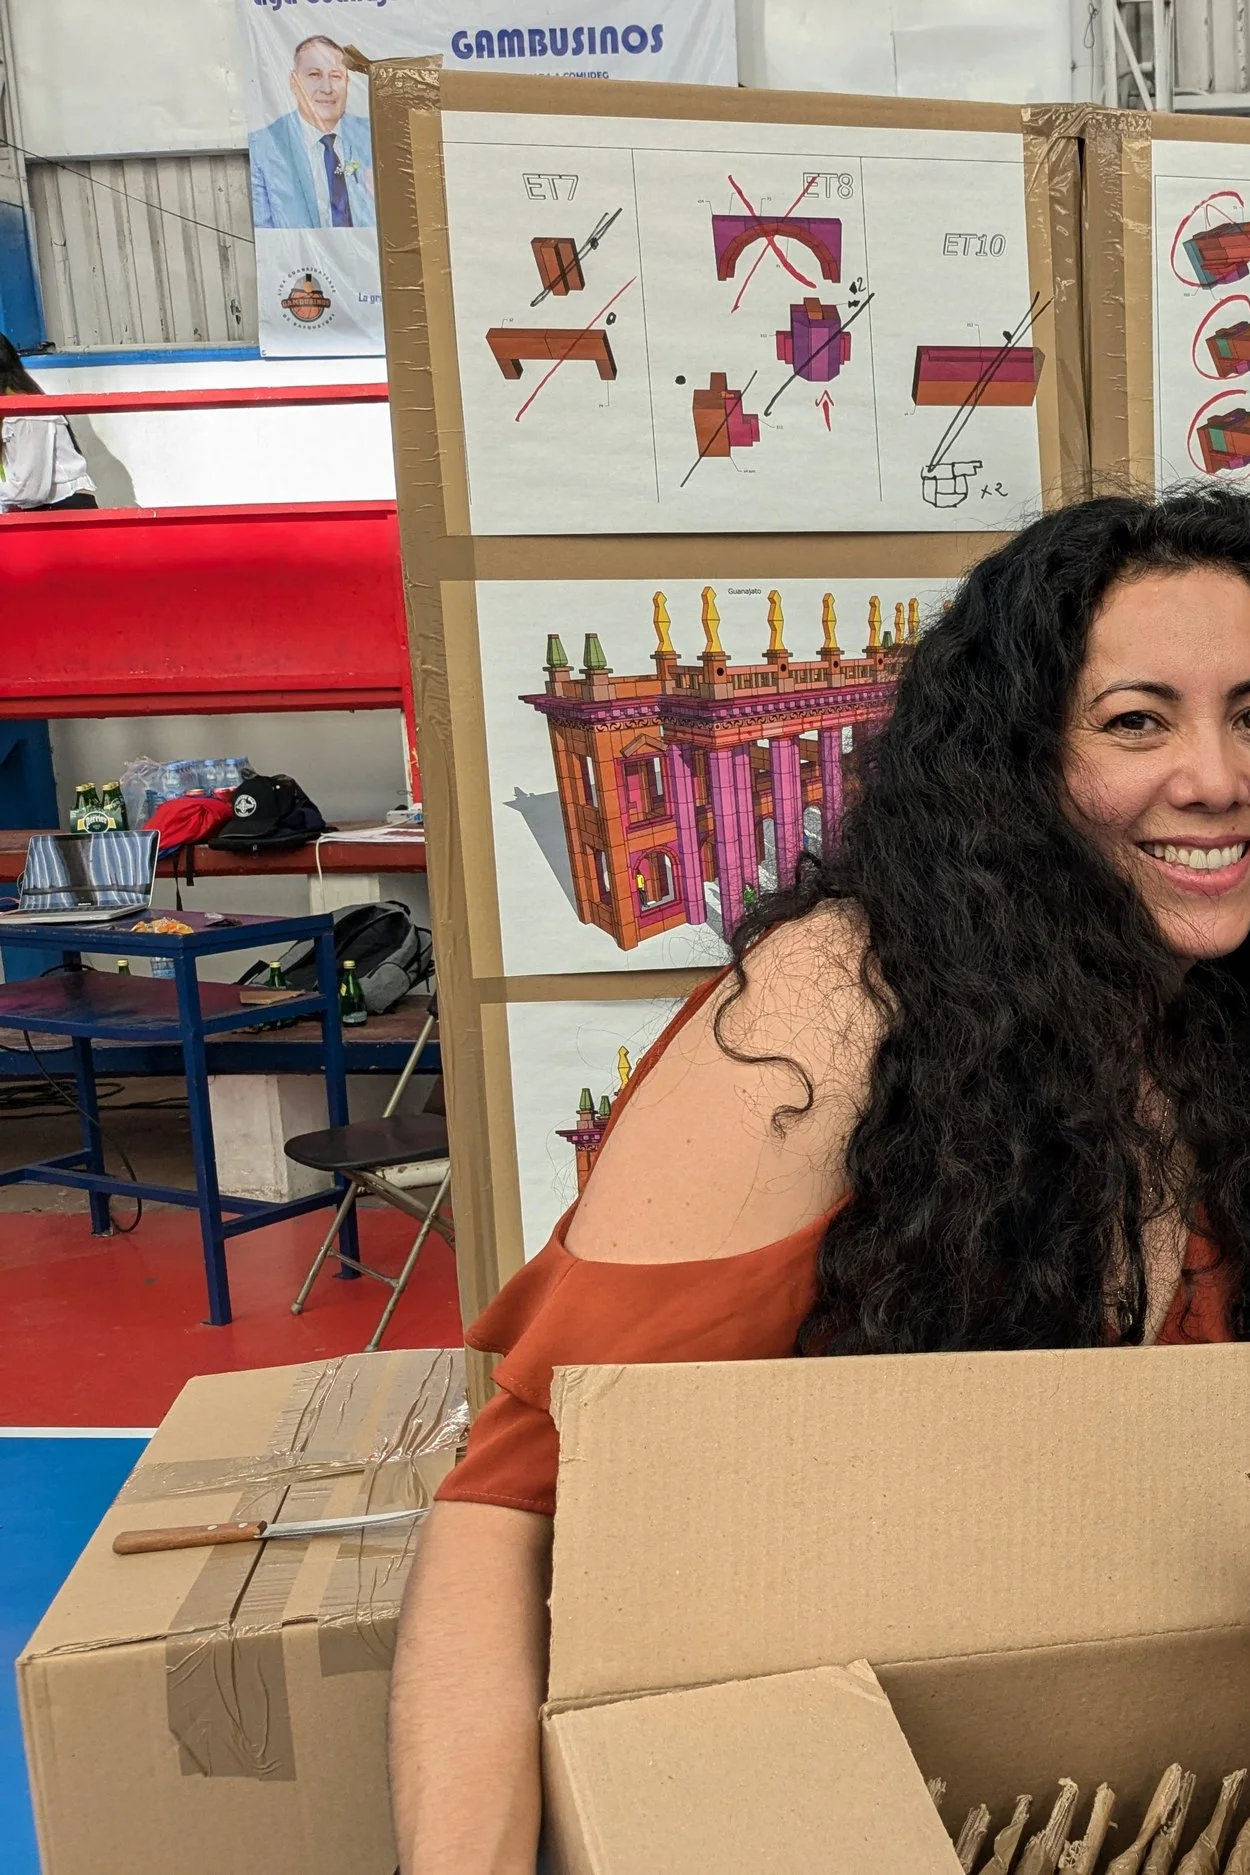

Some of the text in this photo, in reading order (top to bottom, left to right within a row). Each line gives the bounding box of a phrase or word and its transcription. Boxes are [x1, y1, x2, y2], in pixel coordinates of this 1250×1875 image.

[451, 24, 664, 60] GAMBUSINOS
[522, 173, 579, 201] ET7
[803, 172, 854, 199] ET8
[942, 233, 1006, 257] ET10
